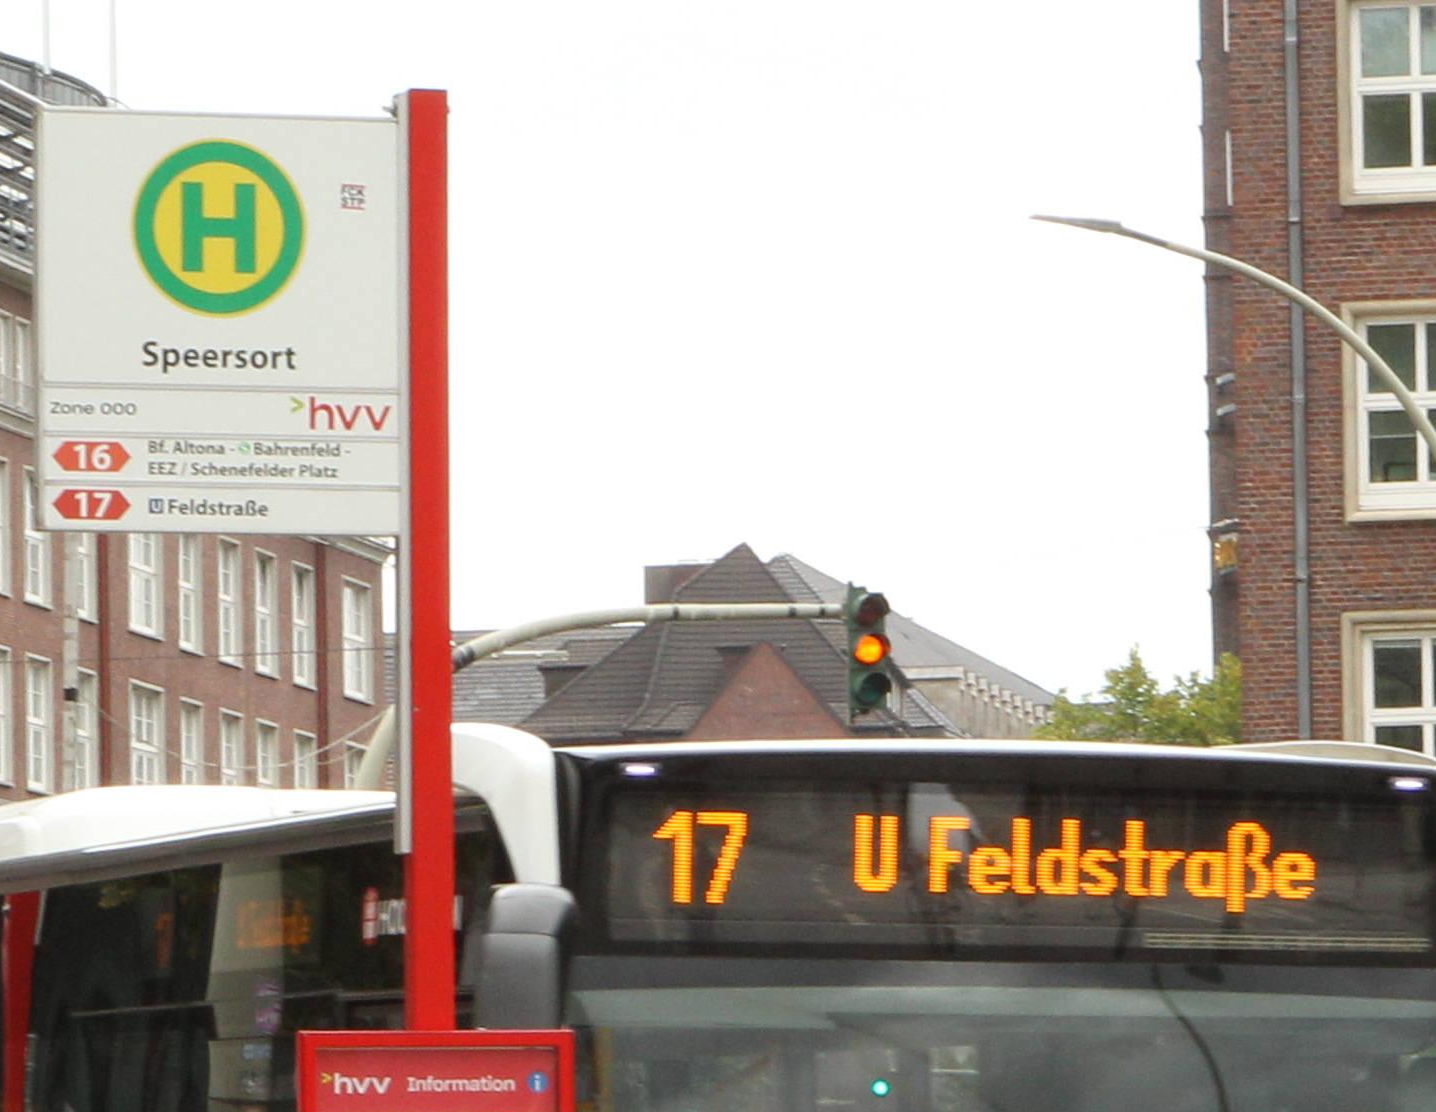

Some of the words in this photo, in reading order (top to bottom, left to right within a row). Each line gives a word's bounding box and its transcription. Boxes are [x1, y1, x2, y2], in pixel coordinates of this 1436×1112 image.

[180, 181, 257, 273] H
[142, 341, 297, 374] Speersort
[50, 401, 95, 415] Zone
[100, 402, 137, 416] 000
[309, 396, 392, 431] hvv
[73, 444, 113, 470] 16
[148, 441, 170, 454] Bf.
[173, 441, 226, 456] Altona
[253, 442, 341, 457] Bahrenfeld
[148, 462, 178, 476] EEZ
[191, 462, 295, 478] Schenefelder
[299, 464, 339, 479] Platz
[74, 492, 115, 518] 17
[168, 499, 269, 517] Feldstraße
[652, 811, 748, 903] 17
[854, 814, 899, 893] U
[929, 815, 1316, 913] Feldstraße
[334, 1072, 392, 1095] hvv
[406, 1076, 516, 1093] Information
